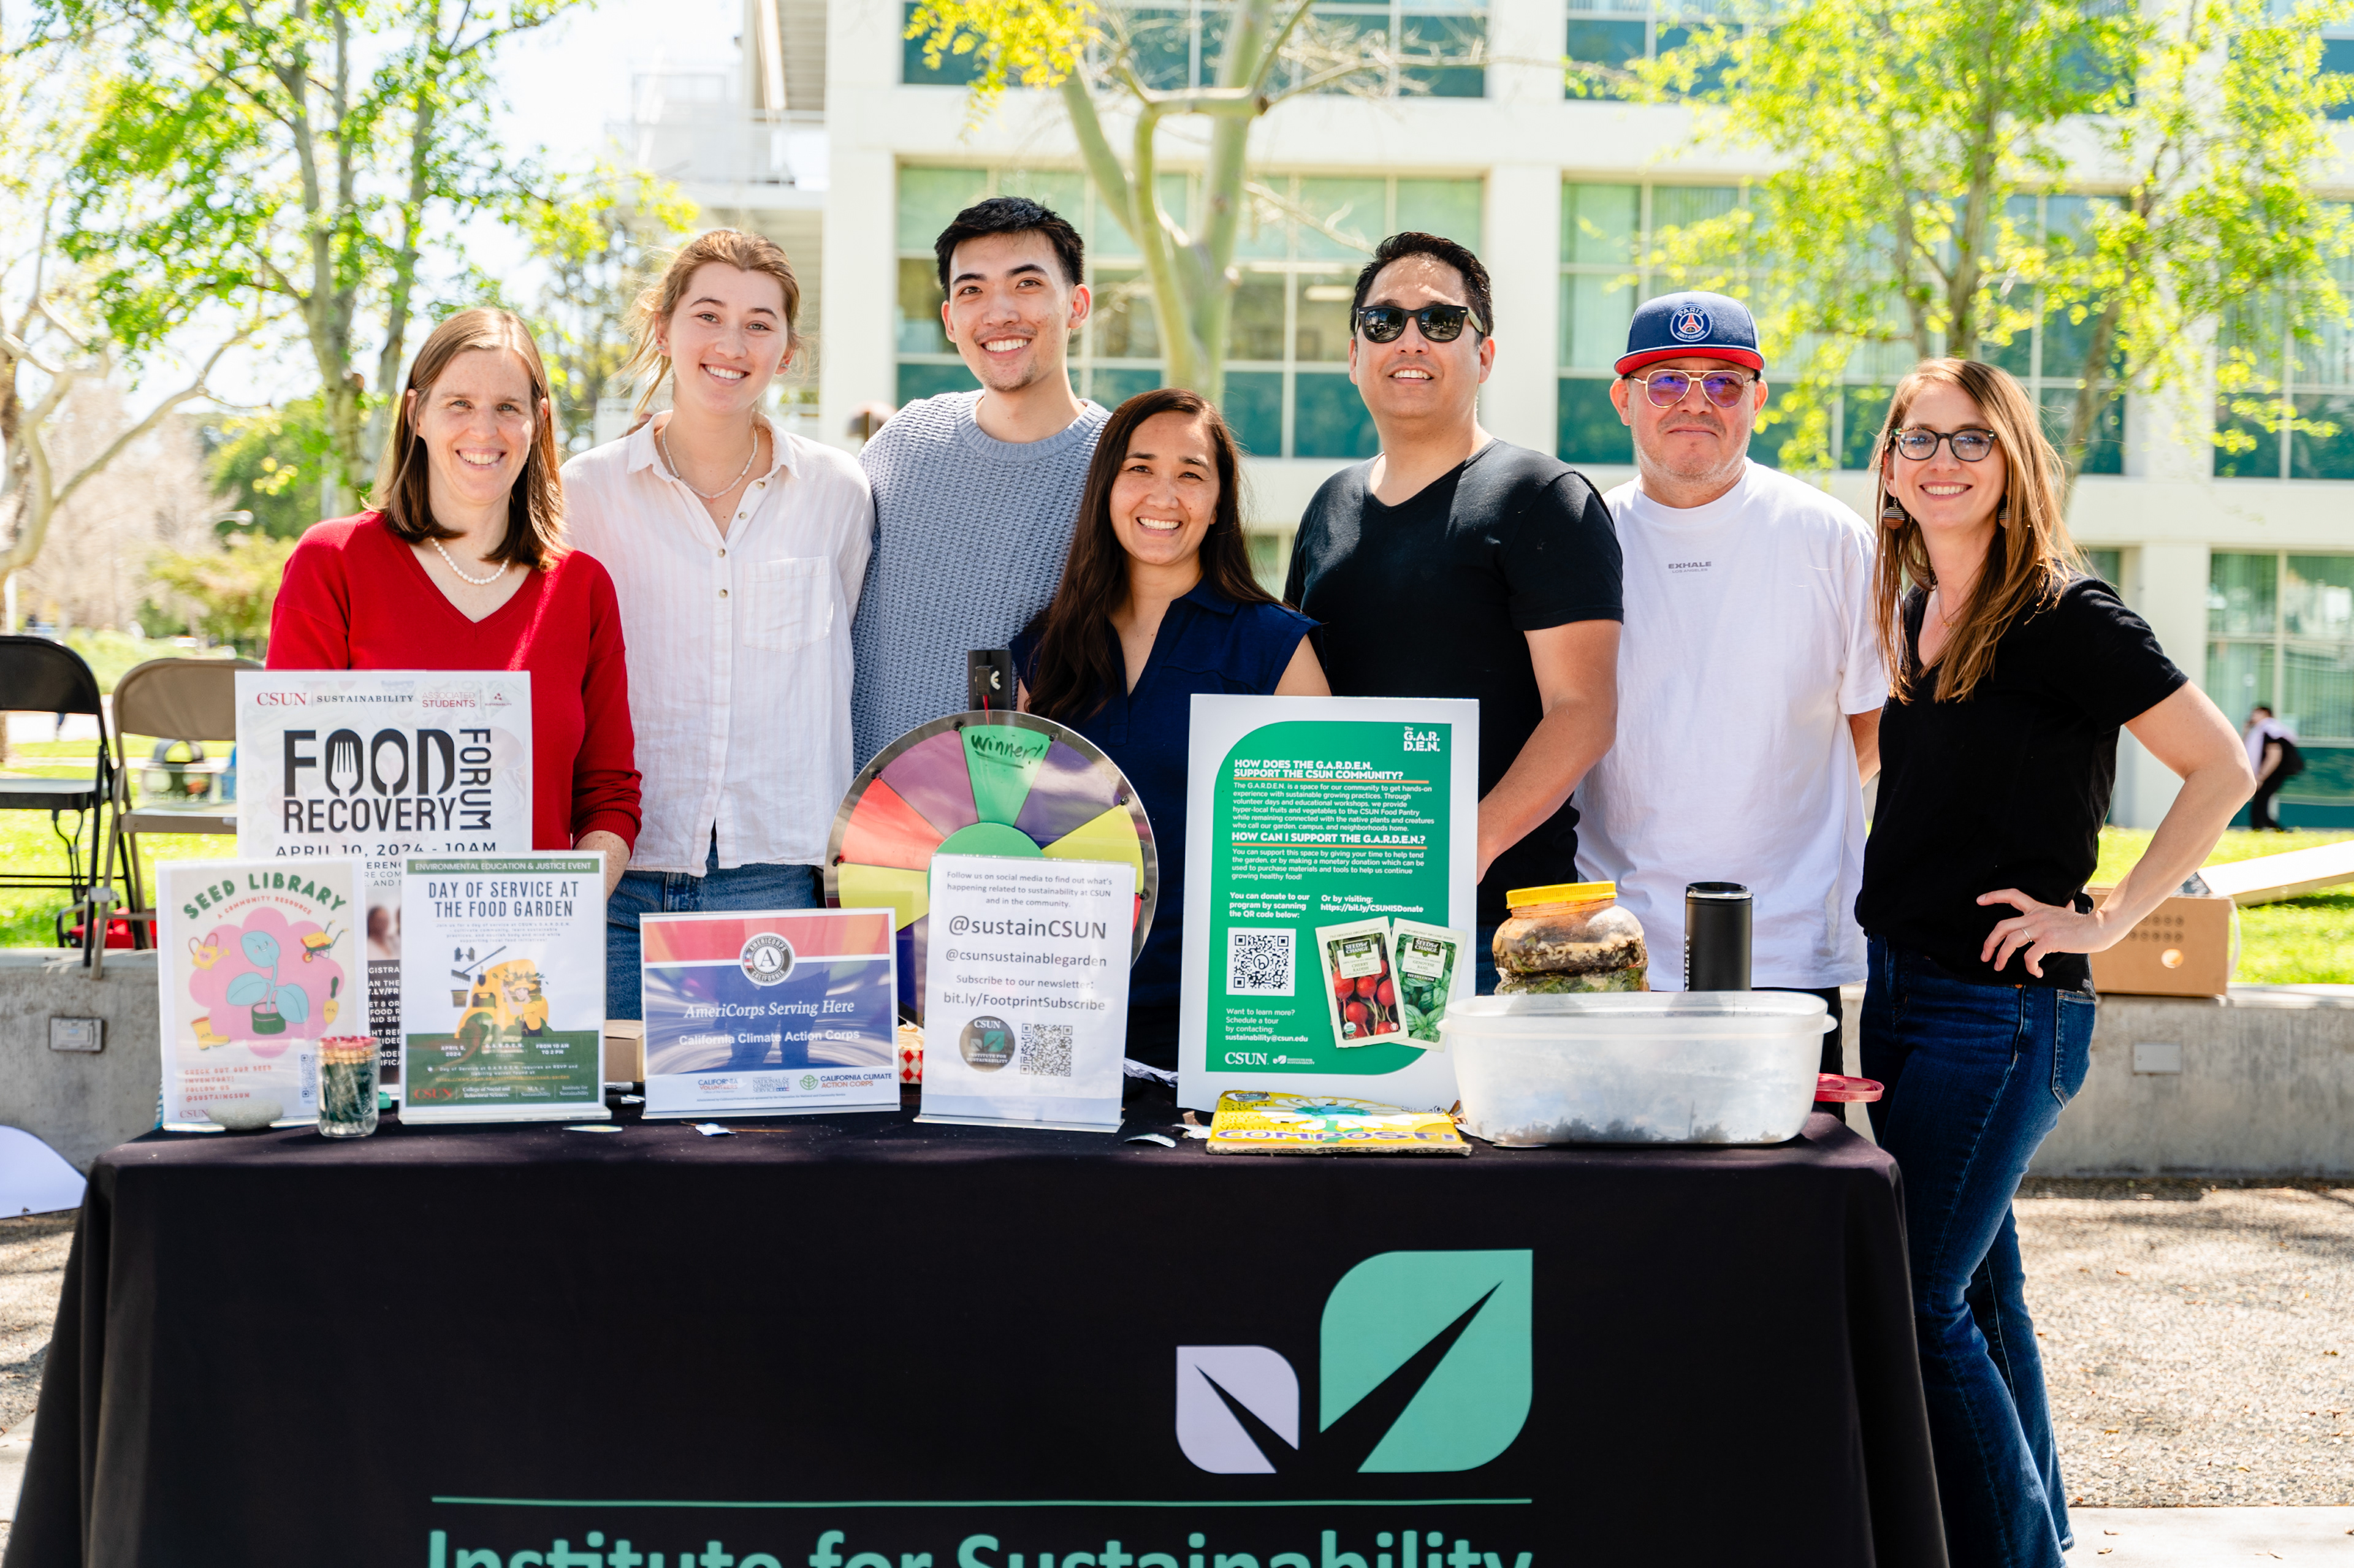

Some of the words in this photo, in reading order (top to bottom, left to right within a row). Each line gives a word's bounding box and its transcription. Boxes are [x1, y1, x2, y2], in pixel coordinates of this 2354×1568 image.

[1677, 307, 1705, 317] PARIS
[256, 692, 307, 706] CSUN
[1404, 731, 1441, 742] G.A.R.
[1404, 742, 1441, 752] D.E.N.
[284, 729, 455, 797] FOOD
[1235, 759, 1261, 768] HOW
[1263, 759, 1291, 769] DOES
[1293, 760, 1314, 769] THE
[1316, 761, 1373, 771] G.A.R.D.E.N.
[1234, 767, 1281, 777] SUPPORT
[1282, 769, 1303, 777] THE
[1305, 769, 1333, 778] CSUN
[1335, 769, 1404, 779] COMMUNITY?
[459, 729, 491, 831] FORUM
[1343, 784, 1380, 793] community
[284, 797, 456, 834] RECOVERY
[1232, 832, 1259, 841] HOW
[1260, 832, 1283, 842] CAN
[1285, 833, 1289, 842] I
[1290, 833, 1338, 843] SUPPORT
[1339, 834, 1361, 843] THE
[1363, 835, 1426, 844] G.A.R.D.E.N.?
[276, 845, 329, 856] APRIL
[342, 845, 368, 858] 10,
[376, 843, 424, 856] 2024
[445, 842, 497, 852] 10AM
[481, 862, 527, 870] EDUCATION
[429, 882, 459, 898] DAY
[466, 882, 483, 898] OF
[490, 881, 553, 897] SERVICE
[560, 881, 579, 897] AT
[947, 884, 987, 893] happening
[184, 880, 235, 919] SEED
[248, 872, 346, 911] LIBRARY
[1333, 894, 1343, 904] by
[1344, 894, 1373, 905] visiting:
[224, 896, 271, 913] COMMUNITY
[275, 896, 311, 915] RESOURCE
[435, 901, 462, 918] THE
[470, 901, 506, 917] FOOD
[514, 900, 573, 917] GARDEN
[1262, 901, 1273, 911] by
[1273, 901, 1306, 911] scanning
[1320, 904, 1424, 915] https://bit.ly/CSUNISDonate
[949, 916, 1106, 938] @sustainCSUN
[749, 938, 787, 952] AMERICORPS
[758, 949, 777, 967] A
[946, 949, 1107, 967] @csunsustainablegarden
[751, 970, 785, 981] CALIFORNIA
[956, 975, 1003, 985] Subscribe
[1037, 980, 1095, 989] newsletter:
[944, 993, 1105, 1010] bit.ly/FootprintSubscribe
[684, 1004, 764, 1019] AmeriCorps
[769, 1001, 818, 1017] Serving
[822, 1000, 855, 1013] Here
[973, 1020, 1000, 1029] CSUN
[1225, 1025, 1235, 1033] by
[1236, 1025, 1274, 1035] contacting:
[679, 1035, 734, 1046] California
[738, 1033, 781, 1043] Climate
[784, 1032, 821, 1042] Action
[825, 1030, 859, 1042] Corps
[1225, 1033, 1308, 1044] sustainability@csun.edu
[414, 1087, 452, 1100] CSUN
